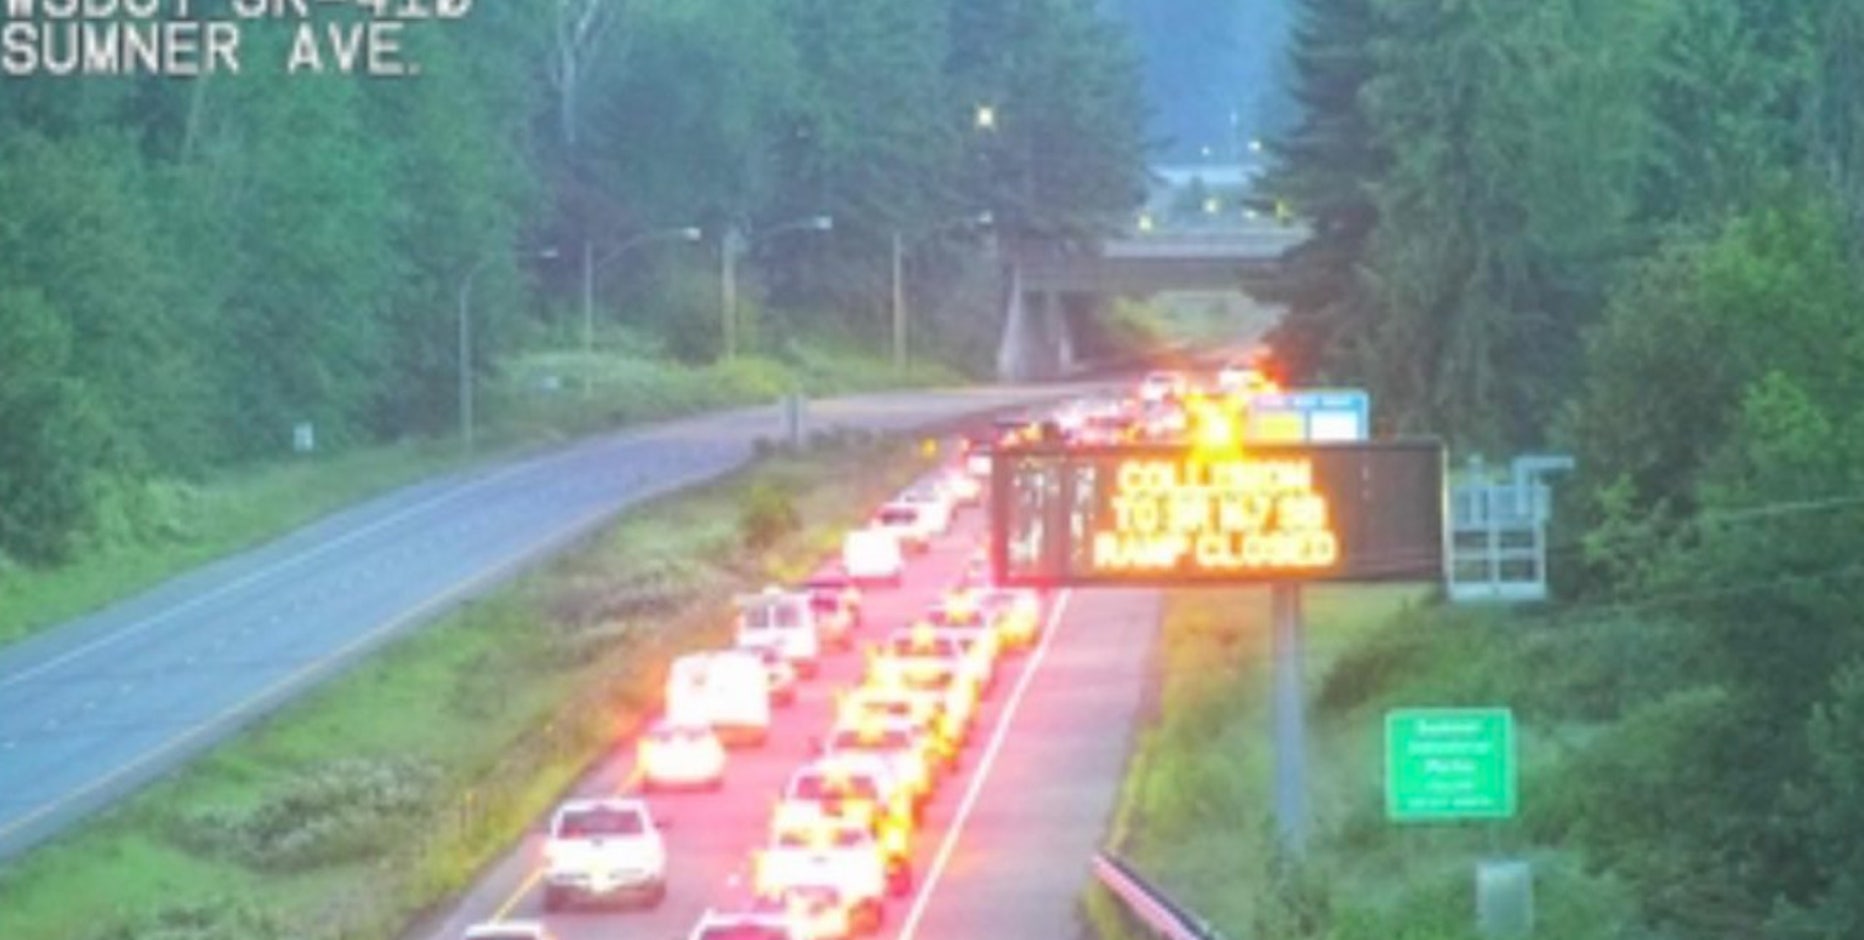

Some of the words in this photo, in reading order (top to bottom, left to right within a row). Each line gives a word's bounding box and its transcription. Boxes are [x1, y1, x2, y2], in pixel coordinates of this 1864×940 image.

[1117, 460, 1313, 492] COLLISION
[1111, 494, 1158, 532] TO
[1094, 531, 1188, 568] RAMP
[1195, 531, 1337, 568] CLOSED
